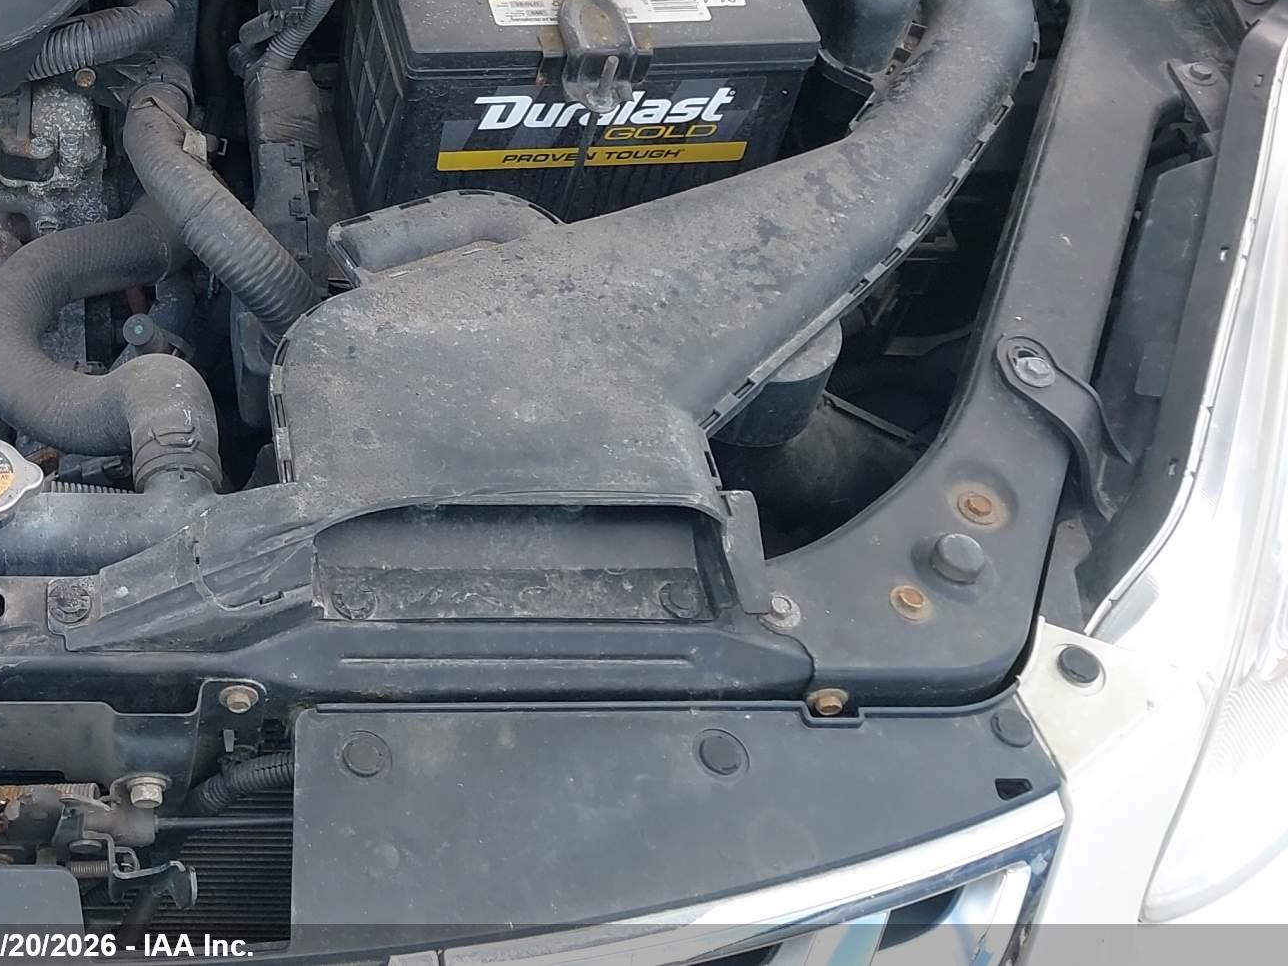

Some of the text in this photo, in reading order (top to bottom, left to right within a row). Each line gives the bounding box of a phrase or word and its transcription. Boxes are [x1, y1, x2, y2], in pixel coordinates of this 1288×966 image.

[603, 124, 718, 142] GOLD
[501, 149, 681, 164] PROVEN TOUGH
